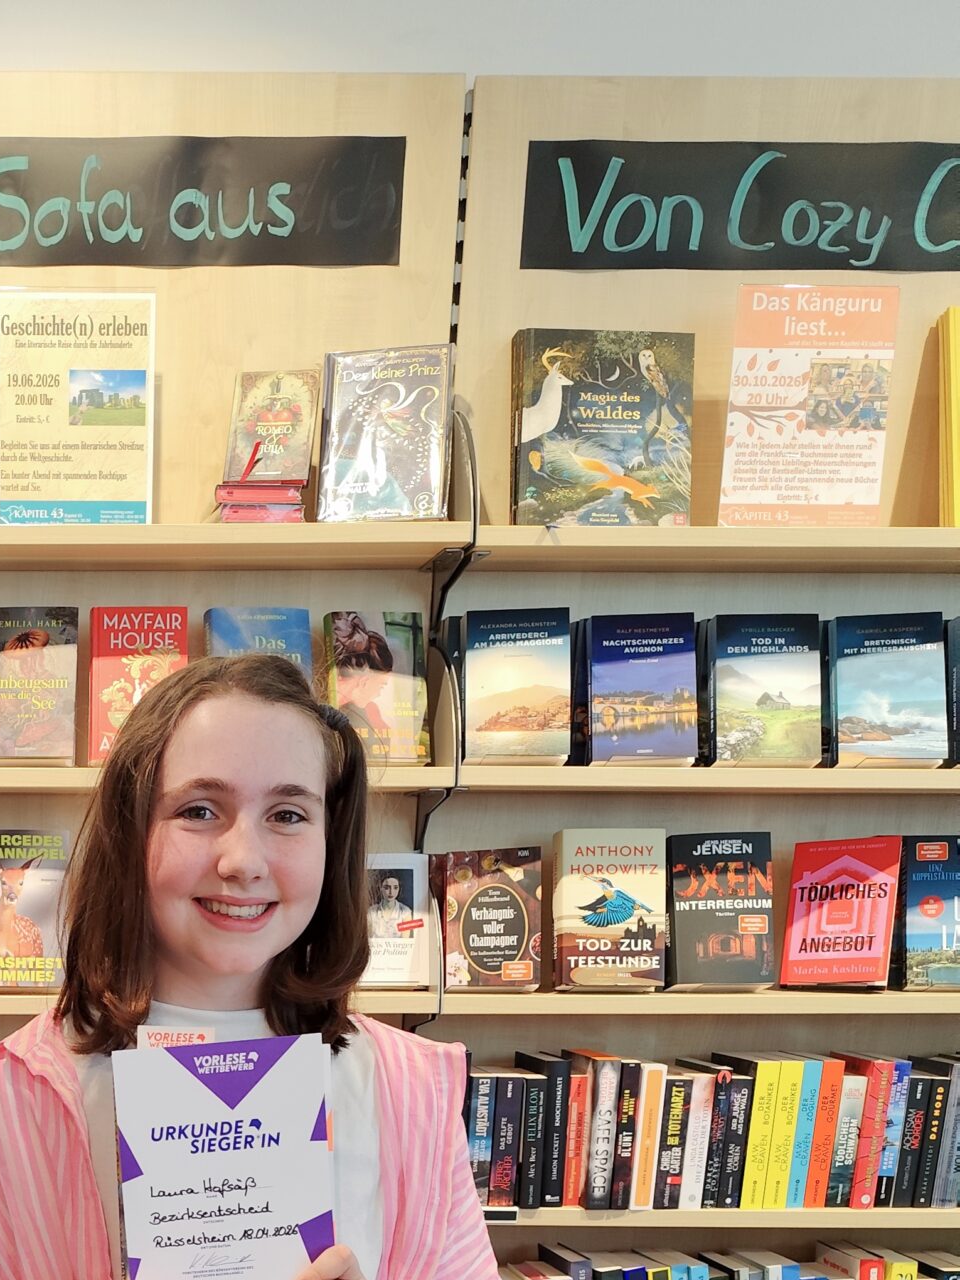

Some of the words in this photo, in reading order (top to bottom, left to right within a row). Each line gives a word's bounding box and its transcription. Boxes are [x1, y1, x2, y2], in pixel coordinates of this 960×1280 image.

[169, 180, 295, 240] aus
[557, 155, 704, 253] Von
[727, 150, 892, 267] Cozy
[753, 292, 790, 311] Das
[797, 292, 883, 316] Känguru
[1, 314, 94, 340] Geschichte(n)
[98, 315, 148, 337] erleben
[783, 316, 846, 337] liest...
[15, 340, 27, 349] Eine
[58, 340, 72, 349] Reise
[73, 340, 88, 349] durch
[98, 340, 133, 349] Jahrhunderte
[371, 366, 405, 380] kleine
[408, 363, 440, 377] Prinz
[7, 373, 60, 388] 19.06.2026
[733, 375, 802, 388] 30.10.2026
[15, 394, 38, 406] 20.00
[40, 394, 53, 406] Uhr
[579, 391, 618, 405] Magie
[619, 391, 641, 403] des
[747, 393, 762, 405] 20
[765, 393, 788, 405] Uhr
[578, 405, 641, 420] Waldes
[255, 424, 292, 436] ROMEO
[258, 444, 284, 455] JULIA
[12, 508, 49, 519] KAPITEL
[50, 508, 64, 519] 43
[36, 619, 64, 627] HART
[103, 613, 182, 630] MAYFAIR
[109, 632, 175, 649] HOUSE
[473, 641, 488, 649] AM
[489, 640, 514, 648] LAGO
[516, 638, 564, 647] MAGGIORE
[488, 632, 549, 641] ARRIVEDERCI
[602, 637, 685, 647] NACHTSCHWARZES
[751, 637, 772, 645] TOD
[775, 637, 786, 645] IN
[864, 638, 917, 647] BRETONISCH
[623, 646, 664, 654] AVIGNON
[727, 646, 749, 654] DEN
[750, 645, 810, 653] HIGHLANDS
[844, 647, 859, 655] MIT
[860, 643, 937, 654] MEERESRAUSCHEN
[0, 691, 15, 700] wie
[17, 691, 32, 700] die
[31, 695, 56, 710] See
[574, 845, 654, 857] ANTHONY
[692, 842, 753, 856] JENSEN
[570, 863, 658, 875] HOROWITZ
[798, 882, 889, 903] TÖDLICHES
[675, 899, 773, 911] INTERREGNUM
[470, 906, 518, 922] Verhängnis-
[482, 920, 505, 934] voller
[469, 934, 518, 949] Champagner
[575, 938, 612, 951] TOD
[619, 938, 653, 951] ZUR
[798, 935, 877, 954] ANGEBOT
[567, 956, 660, 968] TEESTUNDE
[793, 965, 828, 975] Marisa
[146, 1031, 195, 1043] VORLESE
[193, 1052, 247, 1068] VORLESE
[197, 1062, 254, 1075] WETTBEWERB
[478, 1078, 491, 1096] EVA
[668, 1085, 686, 1137] TOTENARZT
[763, 1082, 775, 1126] BOTANIKER
[475, 1096, 490, 1137] ALMSTÄDT
[150, 1119, 244, 1142] URKUNDE
[598, 1109, 612, 1144] SAFE
[835, 1116, 851, 1168] TÖDLICHER
[844, 1118, 859, 1166] SCHWARM
[660, 1150, 670, 1171] CHRIS
[668, 1147, 682, 1174] CARTER
[592, 1147, 611, 1194] SPACE
[150, 1186, 200, 1199] Laura
[149, 1201, 273, 1226] Bezirksentscheid
[153, 1232, 236, 1249] Rüsselsheim
